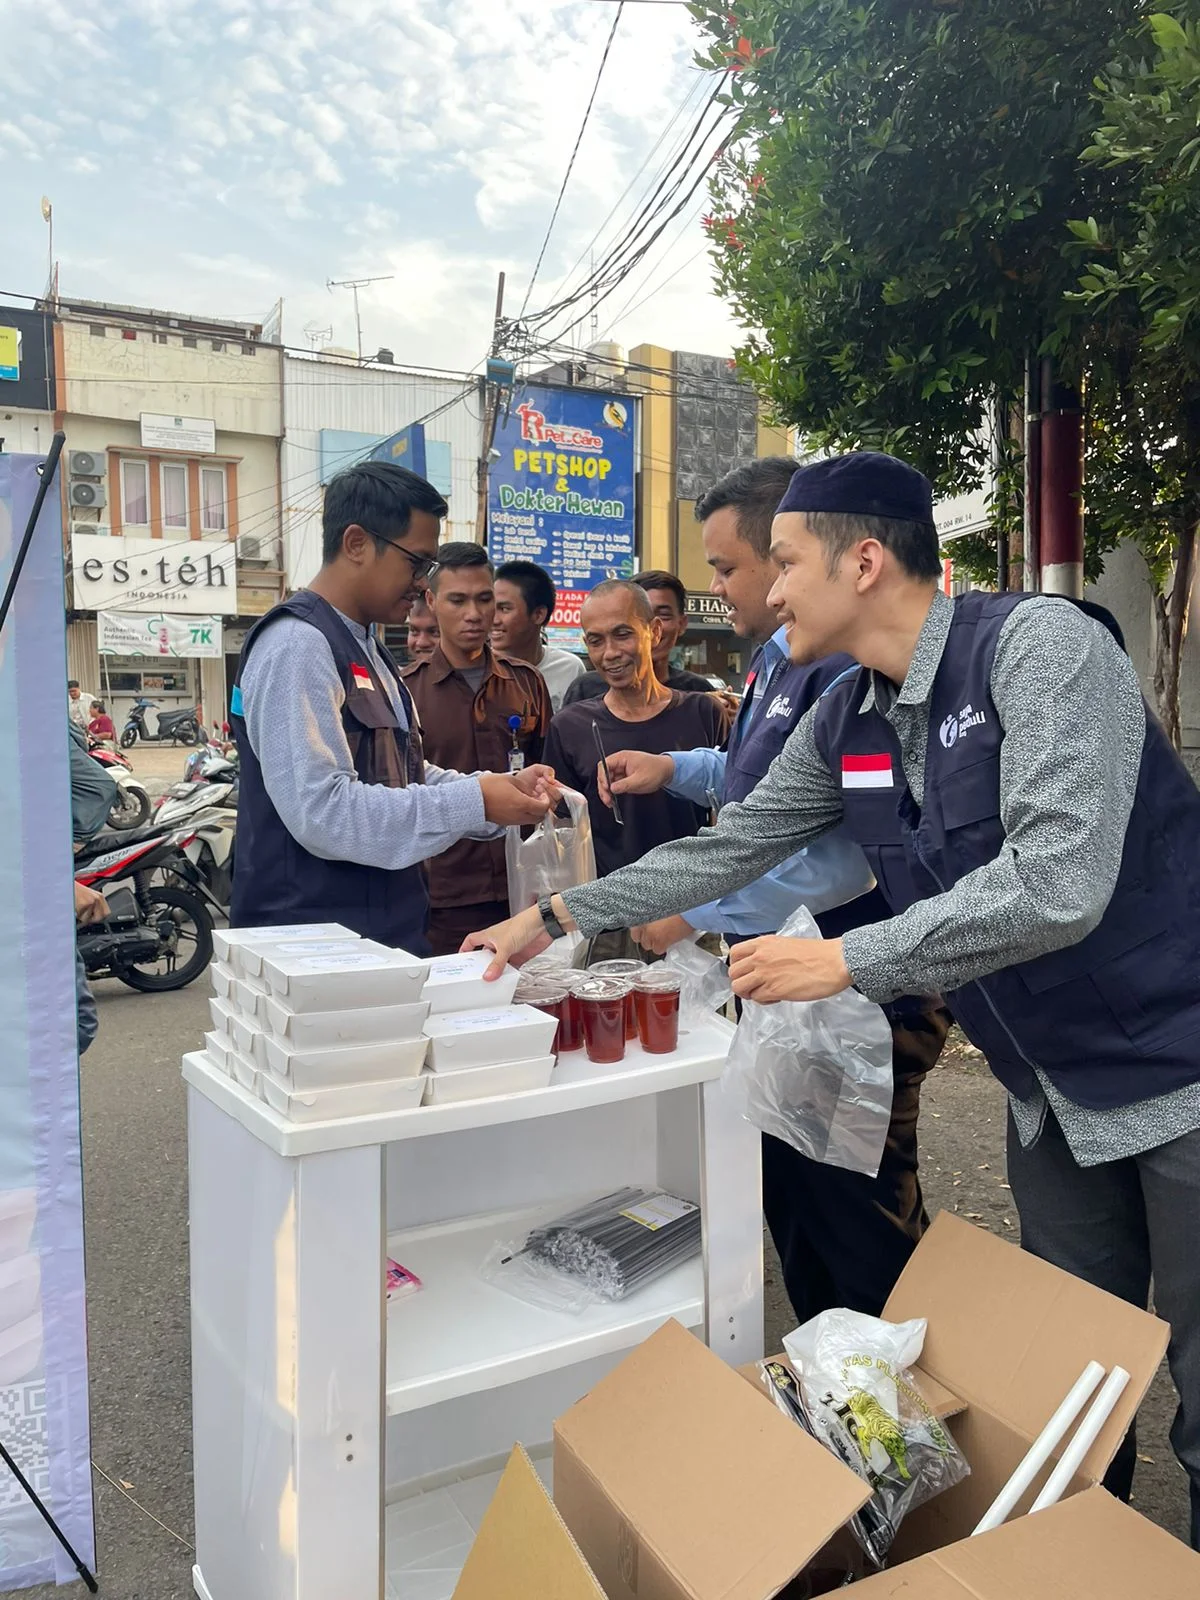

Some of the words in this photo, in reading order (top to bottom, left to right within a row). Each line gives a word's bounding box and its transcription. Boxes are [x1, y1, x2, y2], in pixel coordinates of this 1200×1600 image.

[571, 431, 604, 448] Care
[513, 448, 612, 480] PETSHOP
[555, 477, 571, 492] &
[499, 484, 565, 513] Dokter
[566, 491, 625, 518] Hewan
[126, 591, 188, 600] INDONESIA
[189, 628, 212, 644] 7K
[844, 1353, 873, 1368] TAS
